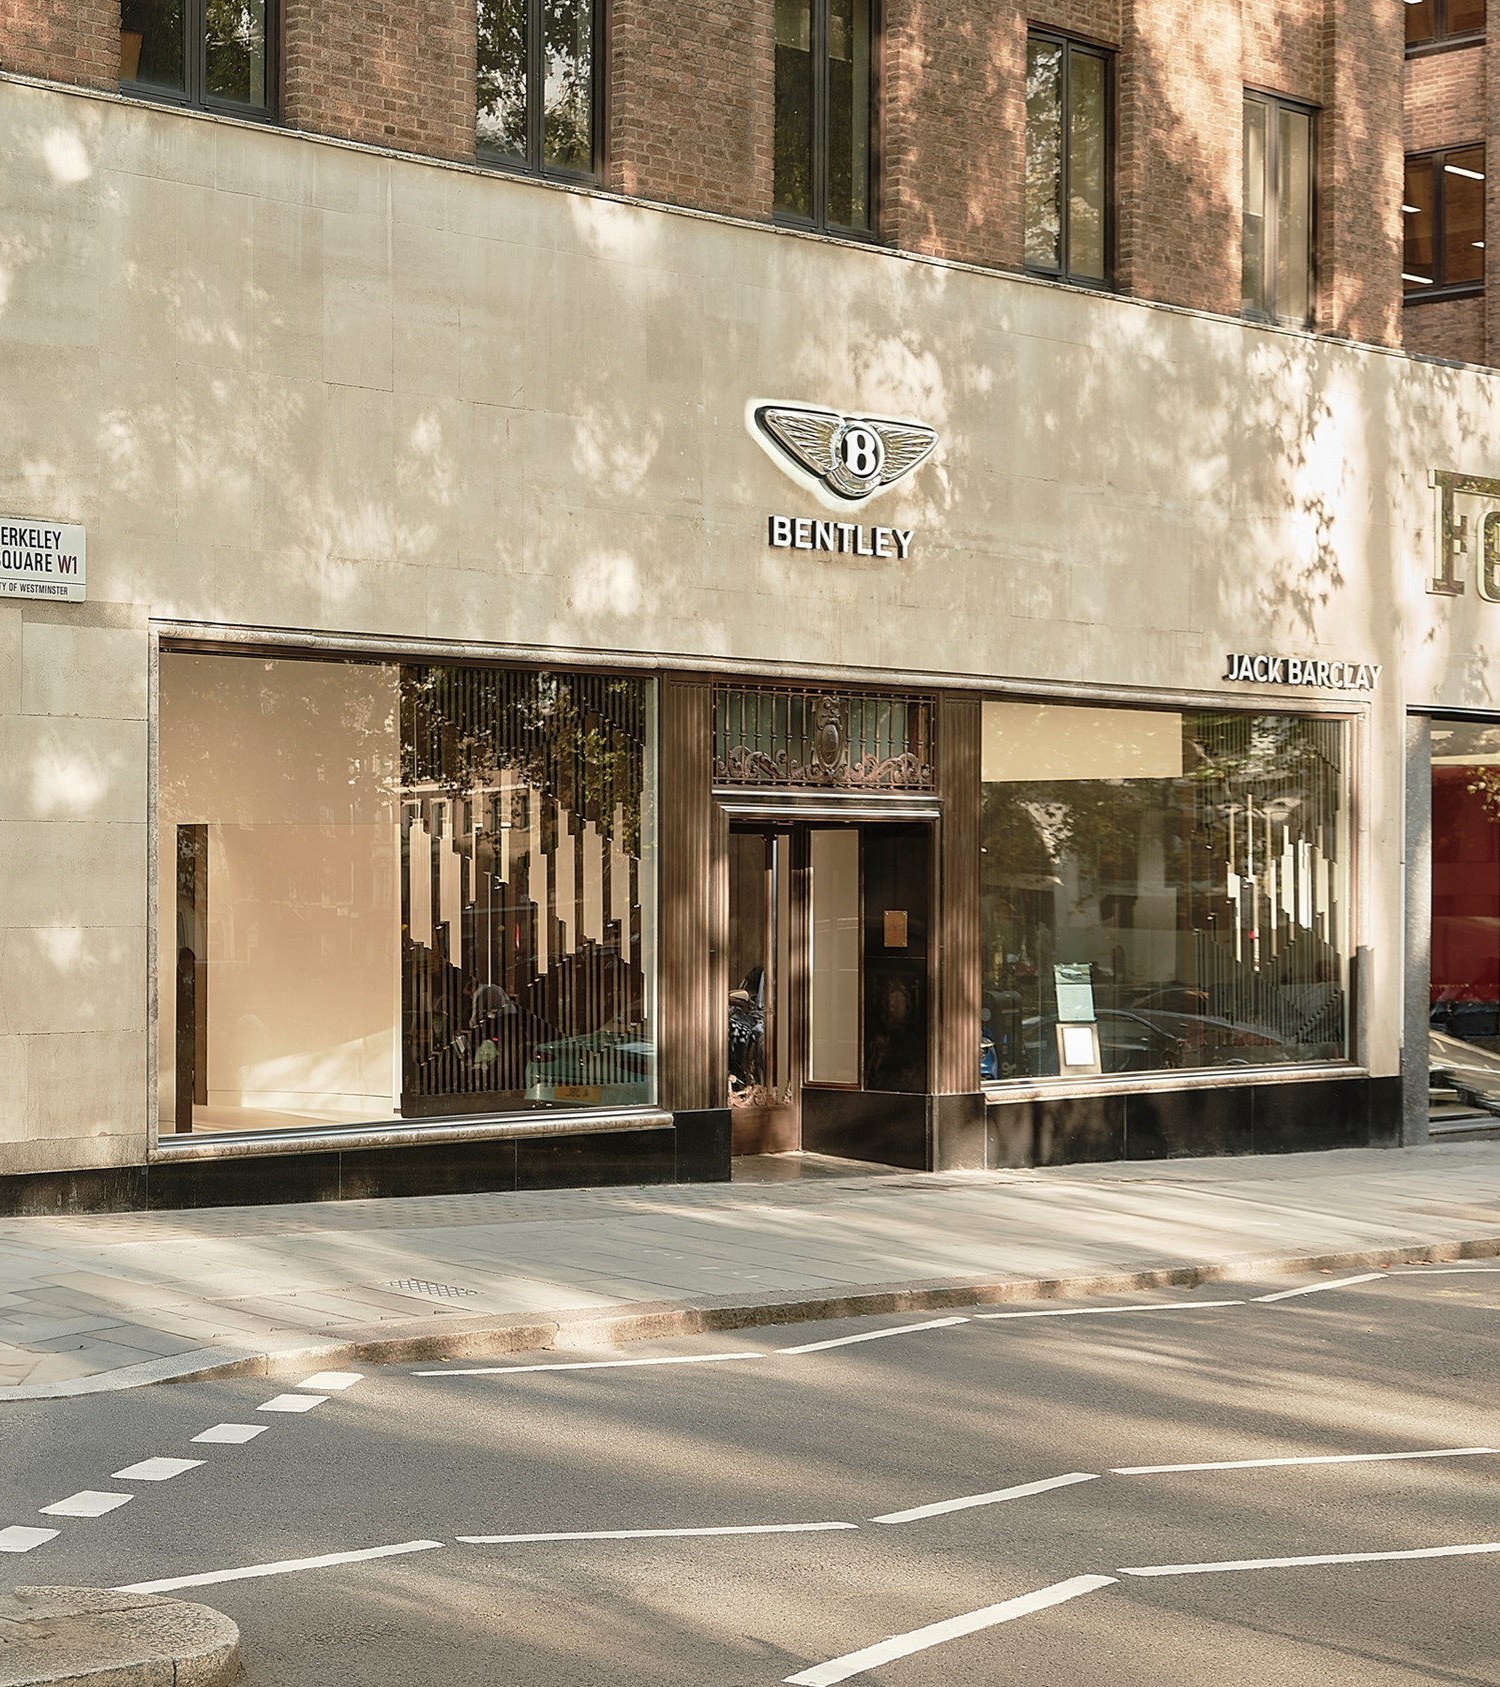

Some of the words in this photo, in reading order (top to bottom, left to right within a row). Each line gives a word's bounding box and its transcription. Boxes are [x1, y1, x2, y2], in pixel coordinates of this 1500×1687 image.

[770, 515, 915, 559] BENTLEY
[57, 554, 78, 575] W1
[9, 582, 17, 592] OF
[20, 583, 68, 595] WESTMINSTER
[1226, 653, 1283, 683] JACK
[1287, 658, 1383, 690] BARCLAY
